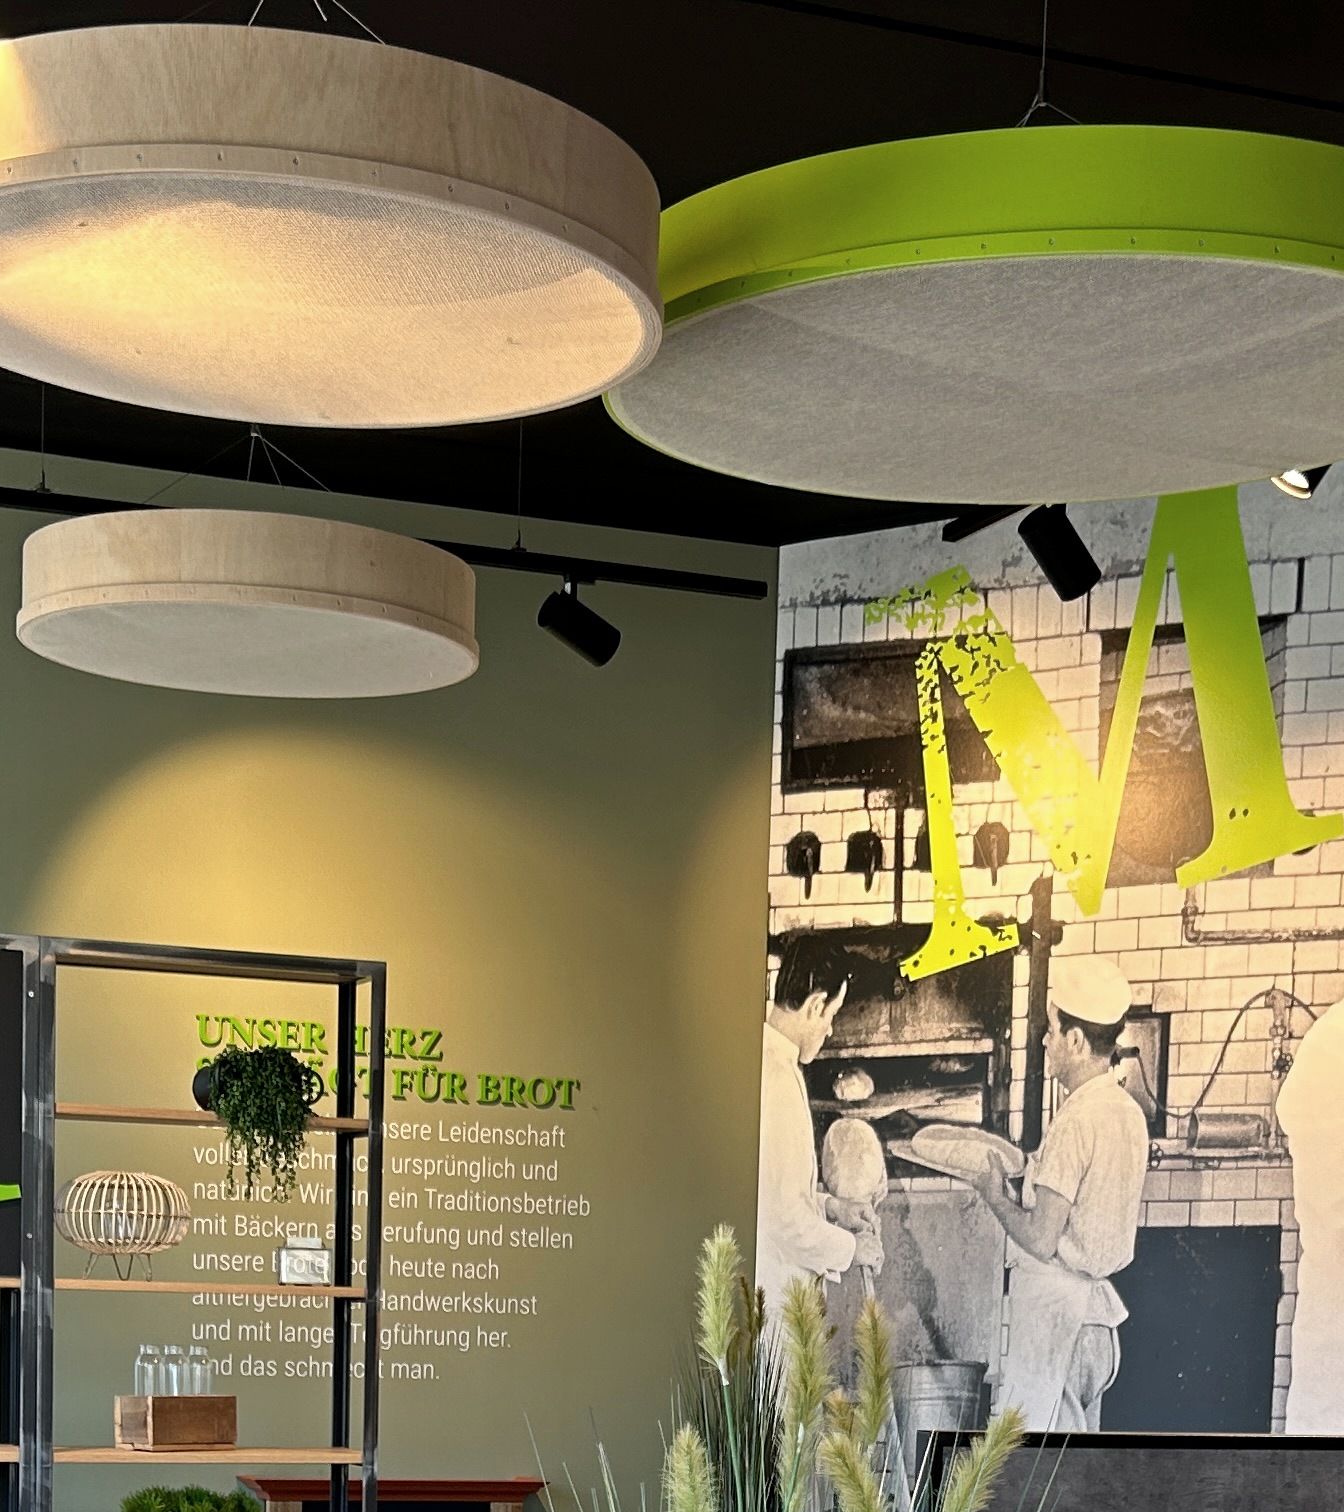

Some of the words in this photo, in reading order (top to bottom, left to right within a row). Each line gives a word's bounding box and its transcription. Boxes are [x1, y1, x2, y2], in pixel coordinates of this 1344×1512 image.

[195, 1014, 328, 1054] UNSER
[392, 1063, 469, 1104] FÜR
[476, 1072, 581, 1111] BROT
[438, 1119, 566, 1148] Leidenschaft
[391, 1154, 516, 1183] ursprünglich
[522, 1159, 558, 1182] und
[299, 1182, 334, 1205] Wir
[388, 1186, 418, 1209] ein
[424, 1187, 591, 1217] Traditionsbetrieb
[193, 1212, 227, 1236] mit
[234, 1214, 318, 1239] Bäckern
[325, 1225, 362, 1242] as
[383, 1221, 460, 1250] erufung
[467, 1224, 503, 1247] und
[509, 1226, 573, 1249] stellen
[193, 1252, 265, 1272] unsere
[389, 1254, 445, 1279] heute
[452, 1258, 499, 1281] nach
[192, 1318, 231, 1341] und
[238, 1319, 271, 1342] mit
[279, 1319, 334, 1349] lange
[350, 1322, 470, 1352] Tgführung
[476, 1326, 512, 1348] her.
[239, 1353, 278, 1377] das
[391, 1361, 440, 1381] man.
